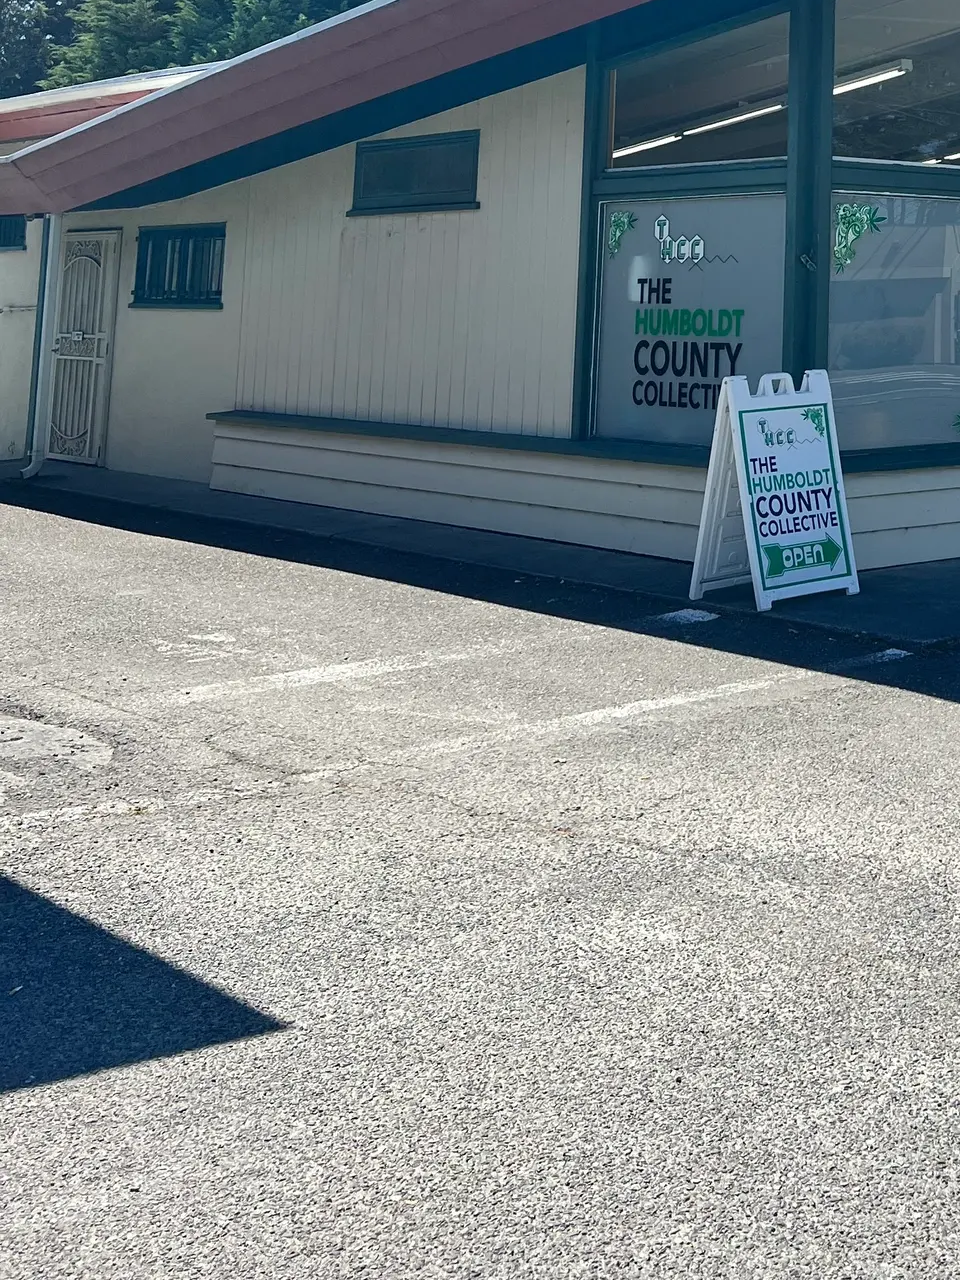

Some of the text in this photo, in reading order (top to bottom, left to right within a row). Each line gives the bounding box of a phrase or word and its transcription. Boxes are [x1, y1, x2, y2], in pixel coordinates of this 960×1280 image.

[637, 278, 672, 304] THE
[634, 308, 745, 337] HUMBOLDT
[633, 340, 743, 378] COUNTY
[632, 379, 722, 410] COLLECTI
[750, 455, 778, 475] THE
[752, 468, 831, 494] HUMBOLDT
[756, 487, 833, 519] COUNTY
[759, 511, 838, 537] COLLECTIVE
[782, 543, 824, 569] OPEN
